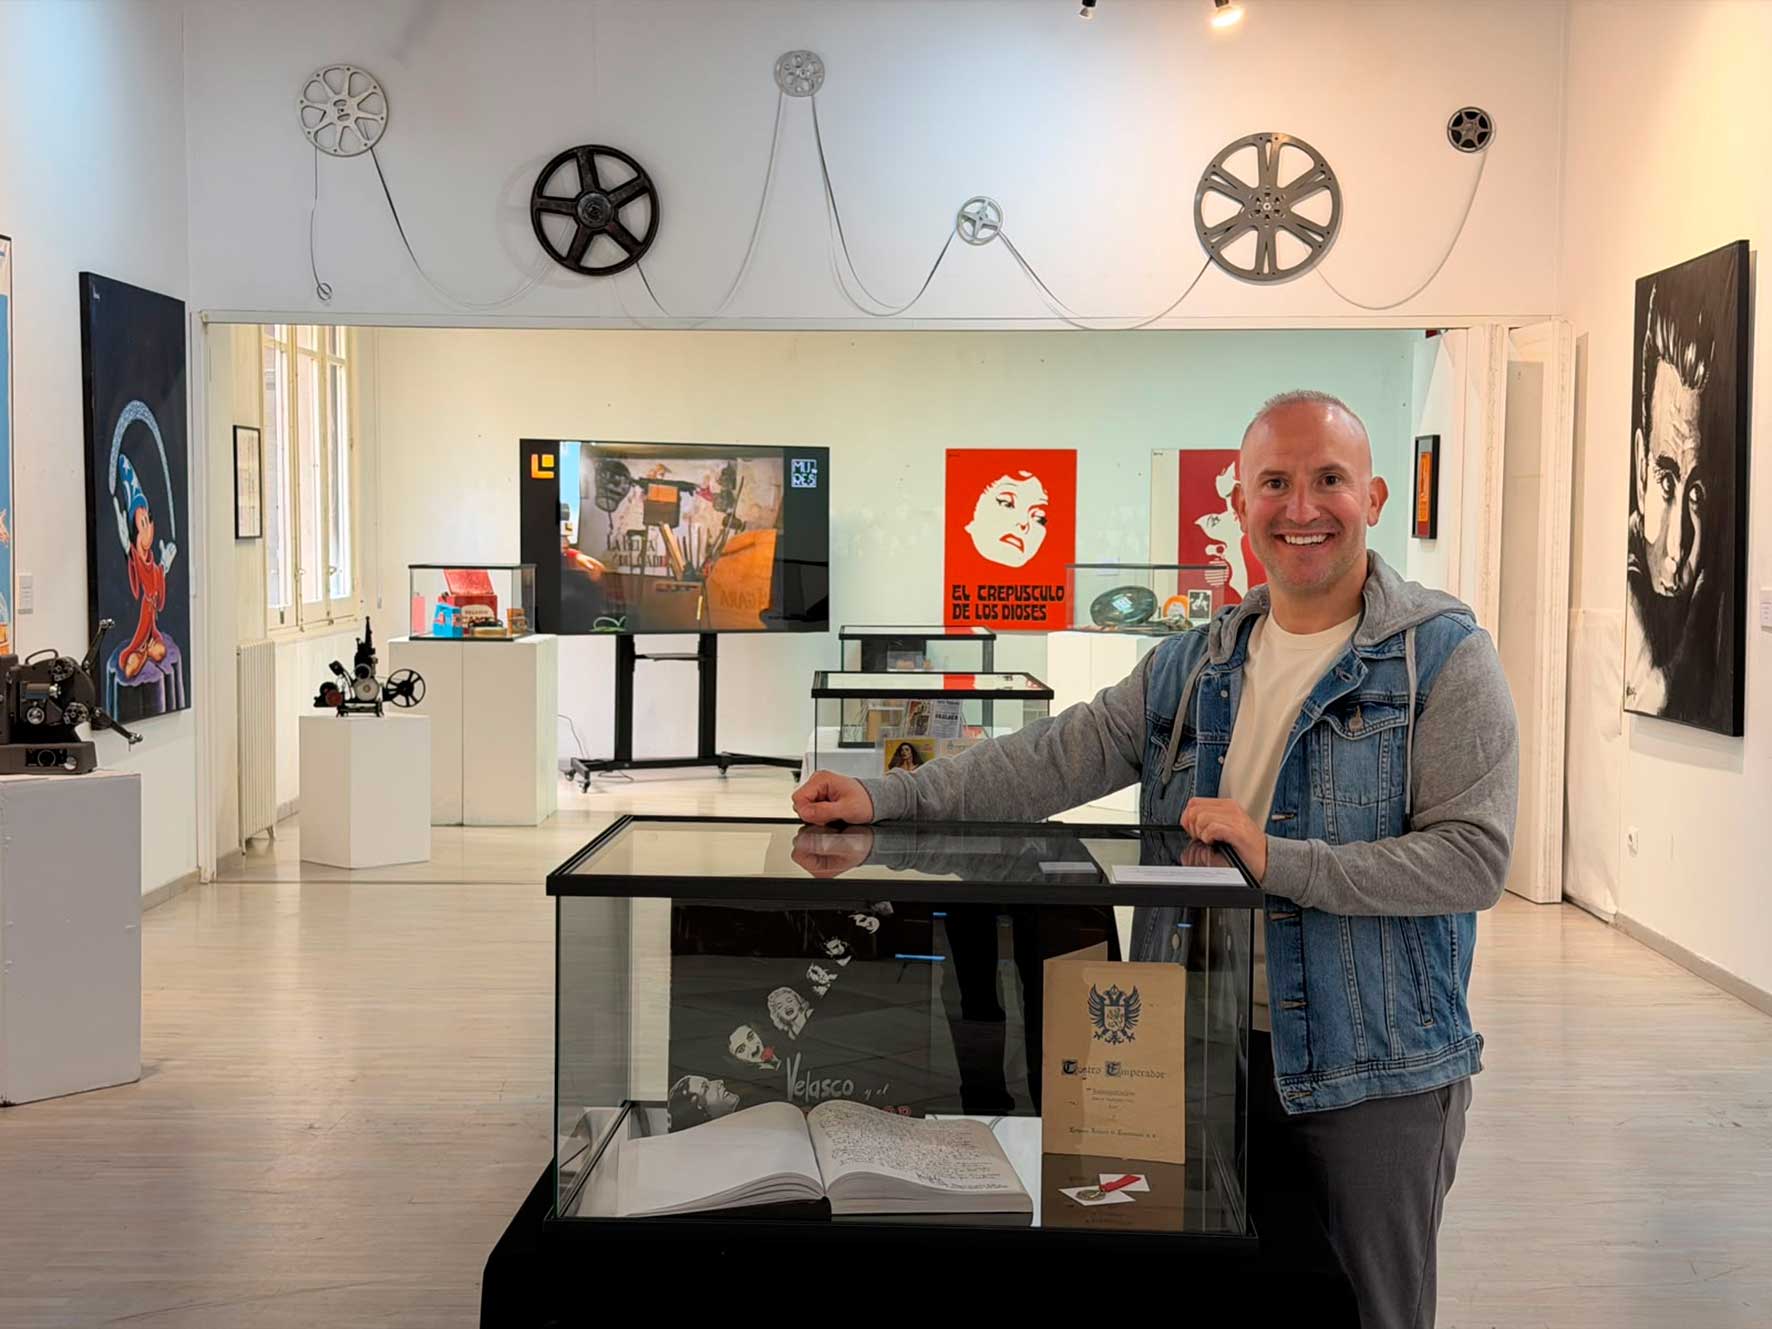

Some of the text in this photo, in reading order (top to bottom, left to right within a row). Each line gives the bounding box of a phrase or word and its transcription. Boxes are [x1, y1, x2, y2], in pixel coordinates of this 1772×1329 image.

[952, 584, 1064, 602] EL CREPUSCULO
[952, 603, 1047, 621] DE LOS DIOSES
[786, 1051, 854, 1103] Velasco
[1105, 1061, 1167, 1079] Emperador
